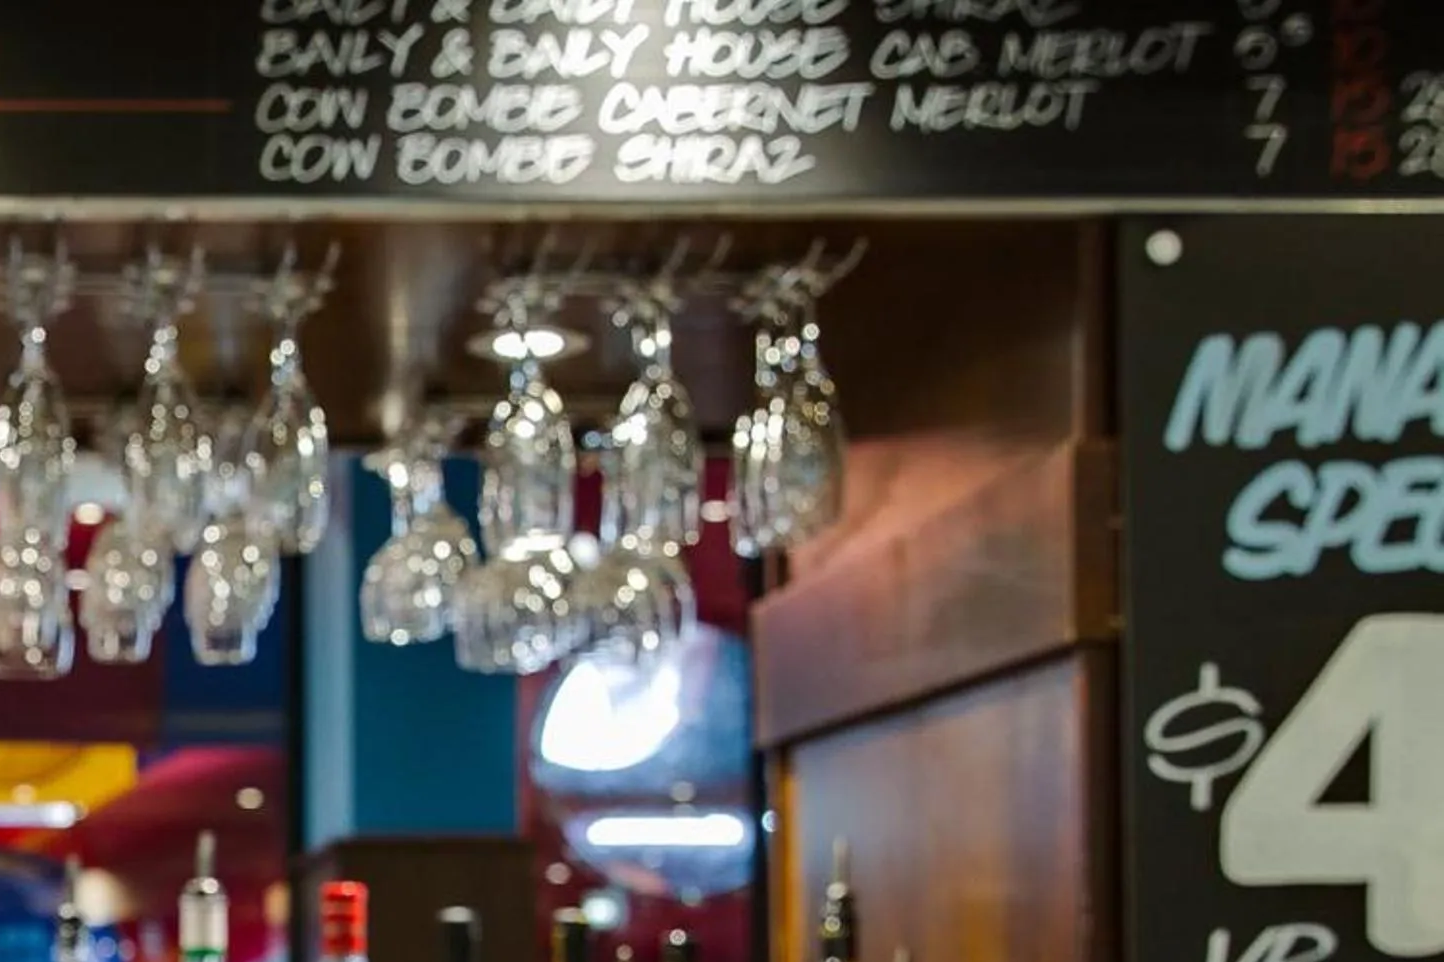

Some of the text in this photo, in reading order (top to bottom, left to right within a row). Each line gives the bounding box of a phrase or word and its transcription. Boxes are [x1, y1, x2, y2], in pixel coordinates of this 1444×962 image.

[431, 27, 473, 77] &
[663, 25, 851, 78] HOUSE
[997, 21, 1212, 76] MERLOT
[598, 81, 874, 134] CABERNET
[891, 79, 1099, 133] MERLOT
[1246, 74, 1286, 122] 7
[260, 133, 381, 182] COW
[614, 133, 815, 184] SHIRAZ
[1244, 124, 1288, 178] 7
[1221, 454, 1444, 581] SPE
